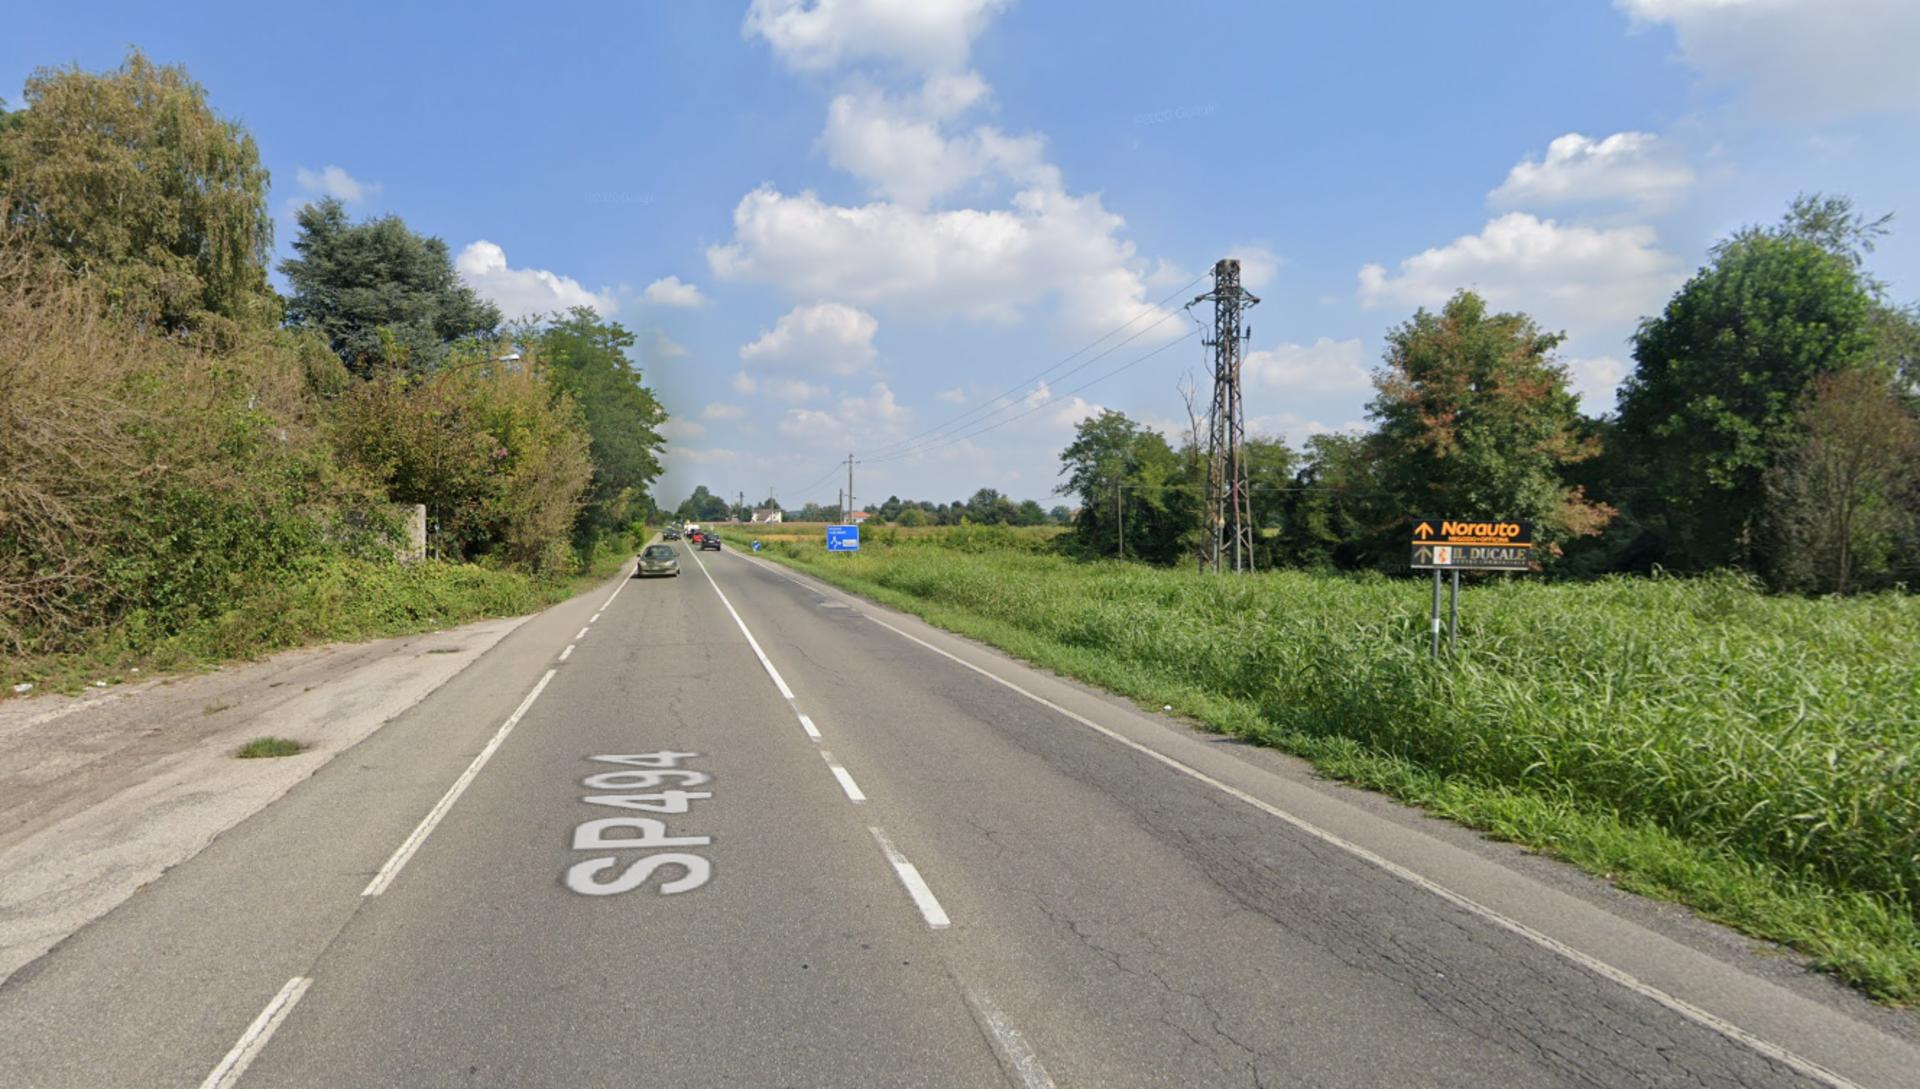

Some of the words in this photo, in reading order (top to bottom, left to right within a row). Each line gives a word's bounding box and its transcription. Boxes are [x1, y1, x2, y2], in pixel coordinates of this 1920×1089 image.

[1441, 521, 1520, 537] Norauto
[1453, 547, 1466, 559] IL
[1470, 548, 1526, 560] DUCALE
